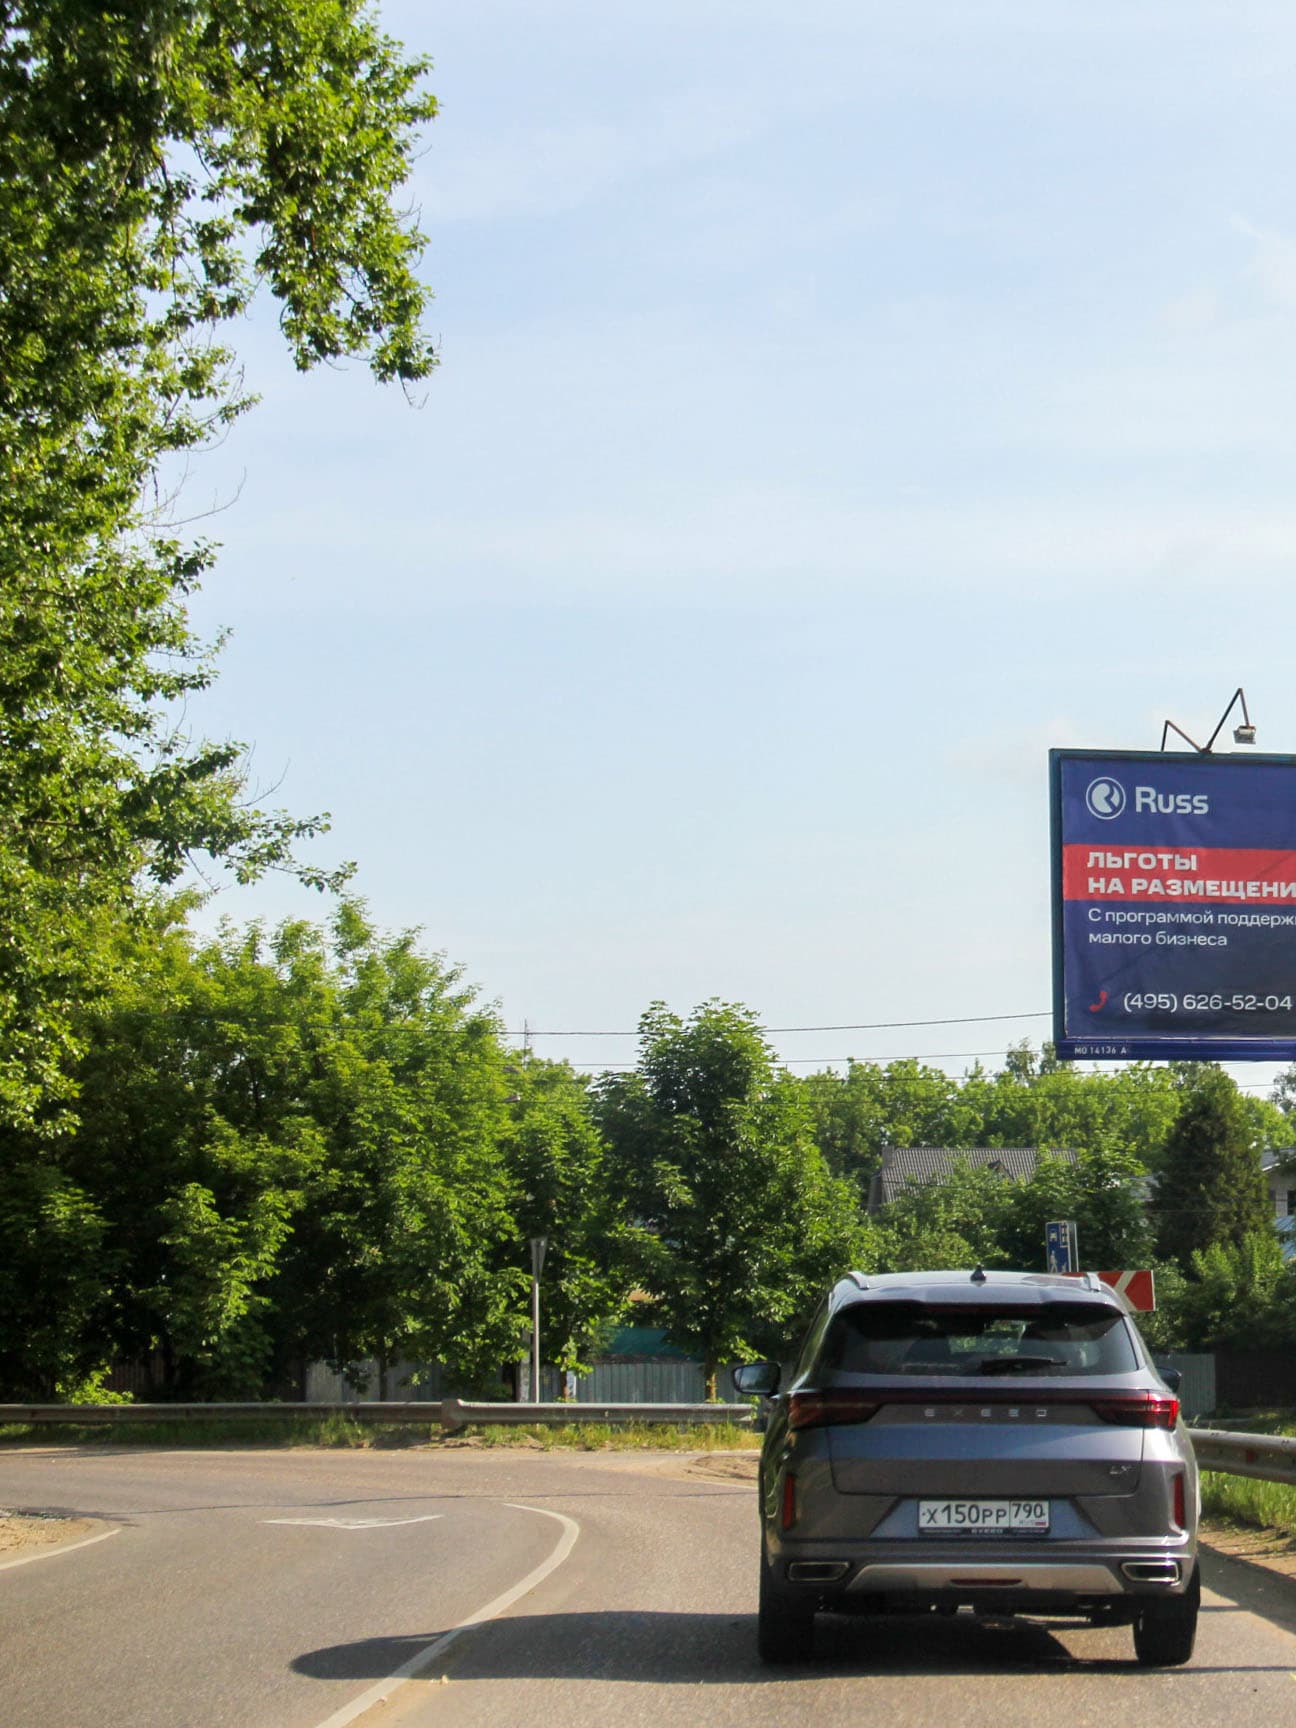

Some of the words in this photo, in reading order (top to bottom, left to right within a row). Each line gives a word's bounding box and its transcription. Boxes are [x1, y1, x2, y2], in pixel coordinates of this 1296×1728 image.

[1135, 786, 1209, 815] Russ
[1087, 852, 1197, 870] ЛЬГОТЫ
[1088, 877, 1125, 894] НА
[1088, 908, 1101, 921] С
[1105, 910, 1213, 926] программой
[1089, 933, 1152, 945] малого
[1155, 931, 1228, 946] бизнеса
[1123, 993, 1178, 1012] (495)
[1183, 995, 1292, 1011] 626-52-04
[1012, 1503, 1044, 1518] 790
